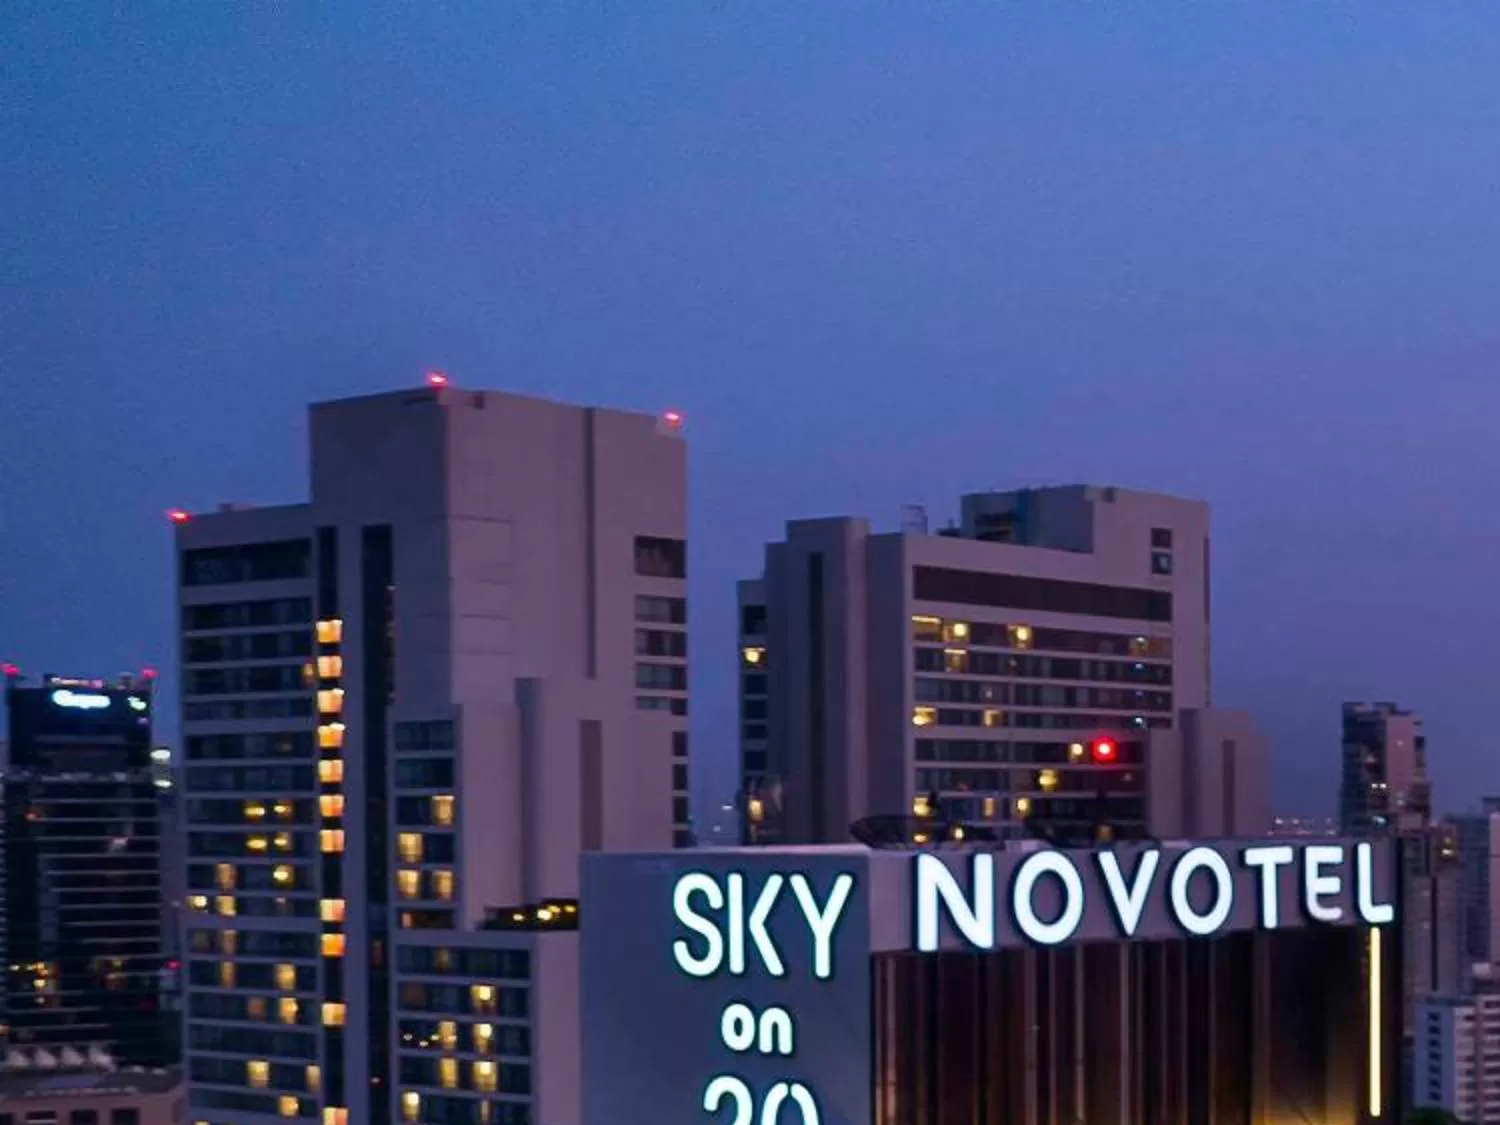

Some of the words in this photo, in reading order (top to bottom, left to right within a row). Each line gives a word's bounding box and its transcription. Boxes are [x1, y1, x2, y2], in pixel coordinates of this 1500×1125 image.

[672, 872, 853, 978] SKY
[914, 842, 1394, 952] NOVOTEL
[720, 1003, 793, 1054] on
